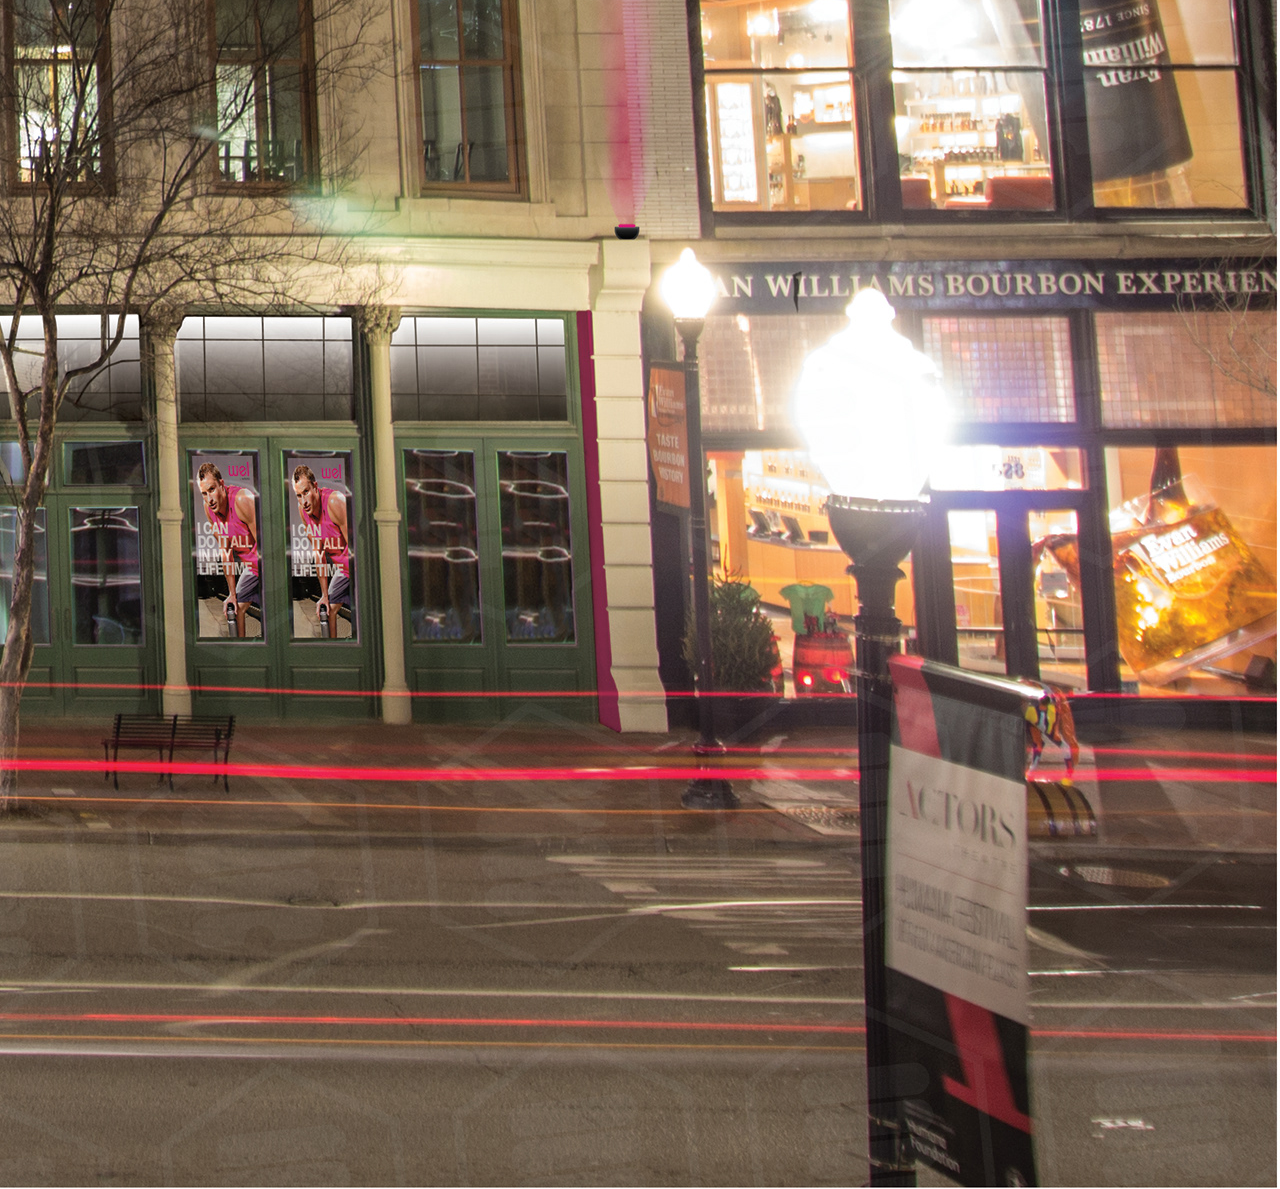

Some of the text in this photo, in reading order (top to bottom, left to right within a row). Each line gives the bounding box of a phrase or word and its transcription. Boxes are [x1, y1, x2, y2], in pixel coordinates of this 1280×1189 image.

[1080, 3, 1150, 33] SINCE 178
[1083, 31, 1165, 66] William
[715, 275, 754, 298] AN
[946, 273, 1105, 297] BOURBON
[656, 433, 679, 449] TASTE
[653, 449, 685, 468] BOURBON
[228, 461, 250, 477] wel
[321, 464, 342, 479] wel
[658, 466, 684, 484] HISTORY
[203, 522, 229, 535] CAN
[298, 524, 322, 537] CAN
[197, 535, 253, 549] DO IT ALL
[293, 537, 344, 550] DO IT ALL
[1140, 523, 1198, 556] Evan
[198, 549, 231, 562] IN MY
[293, 551, 325, 563] IN MY
[1150, 531, 1230, 573] Williams
[199, 562, 253, 576] LIFETIME
[294, 564, 344, 577] LIFETIME
[899, 779, 1017, 850] ACTORS
